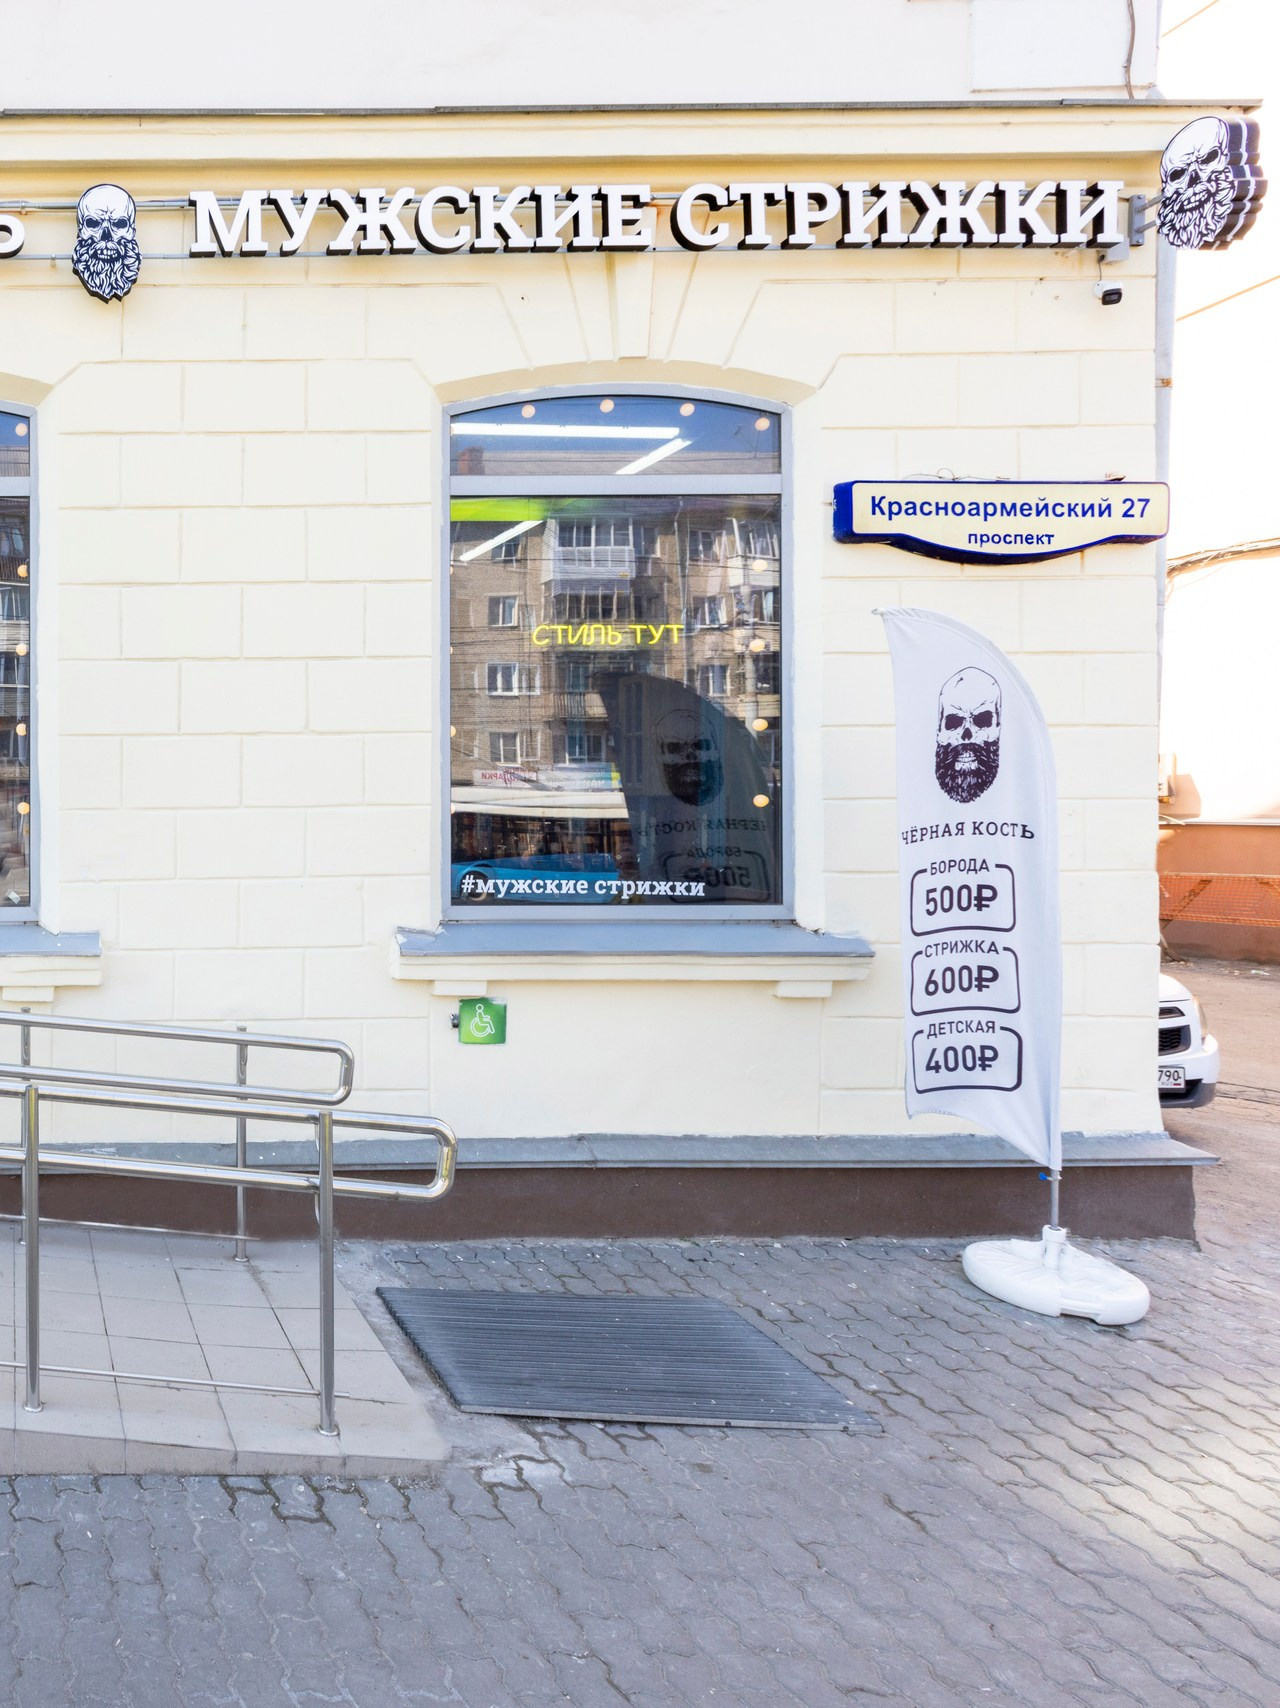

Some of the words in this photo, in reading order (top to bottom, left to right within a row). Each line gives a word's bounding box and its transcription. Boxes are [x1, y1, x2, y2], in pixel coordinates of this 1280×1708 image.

[188, 185, 652, 256] МУЖСКИЕ
[671, 180, 1125, 250] СТРИЖКИ
[870, 496, 1113, 522] Красноармейский
[1121, 497, 1151, 518] 27
[967, 533, 1055, 547] проспект
[532, 624, 623, 645] СТИЛЬ
[628, 624, 685, 645] ТУТ
[901, 821, 966, 845] ЧЁРНАЯ
[971, 821, 1035, 840] КОСТЬ
[930, 858, 990, 876] БОРОДА
[461, 874, 589, 898] #мужские
[600, 876, 706, 899] стрижки
[925, 884, 998, 916] 500₽
[924, 940, 1000, 958] СТРИЖКА
[924, 965, 1000, 996] 600₽
[926, 1020, 996, 1039] ДЕТСКАЯ
[925, 1045, 999, 1074] 400₽
